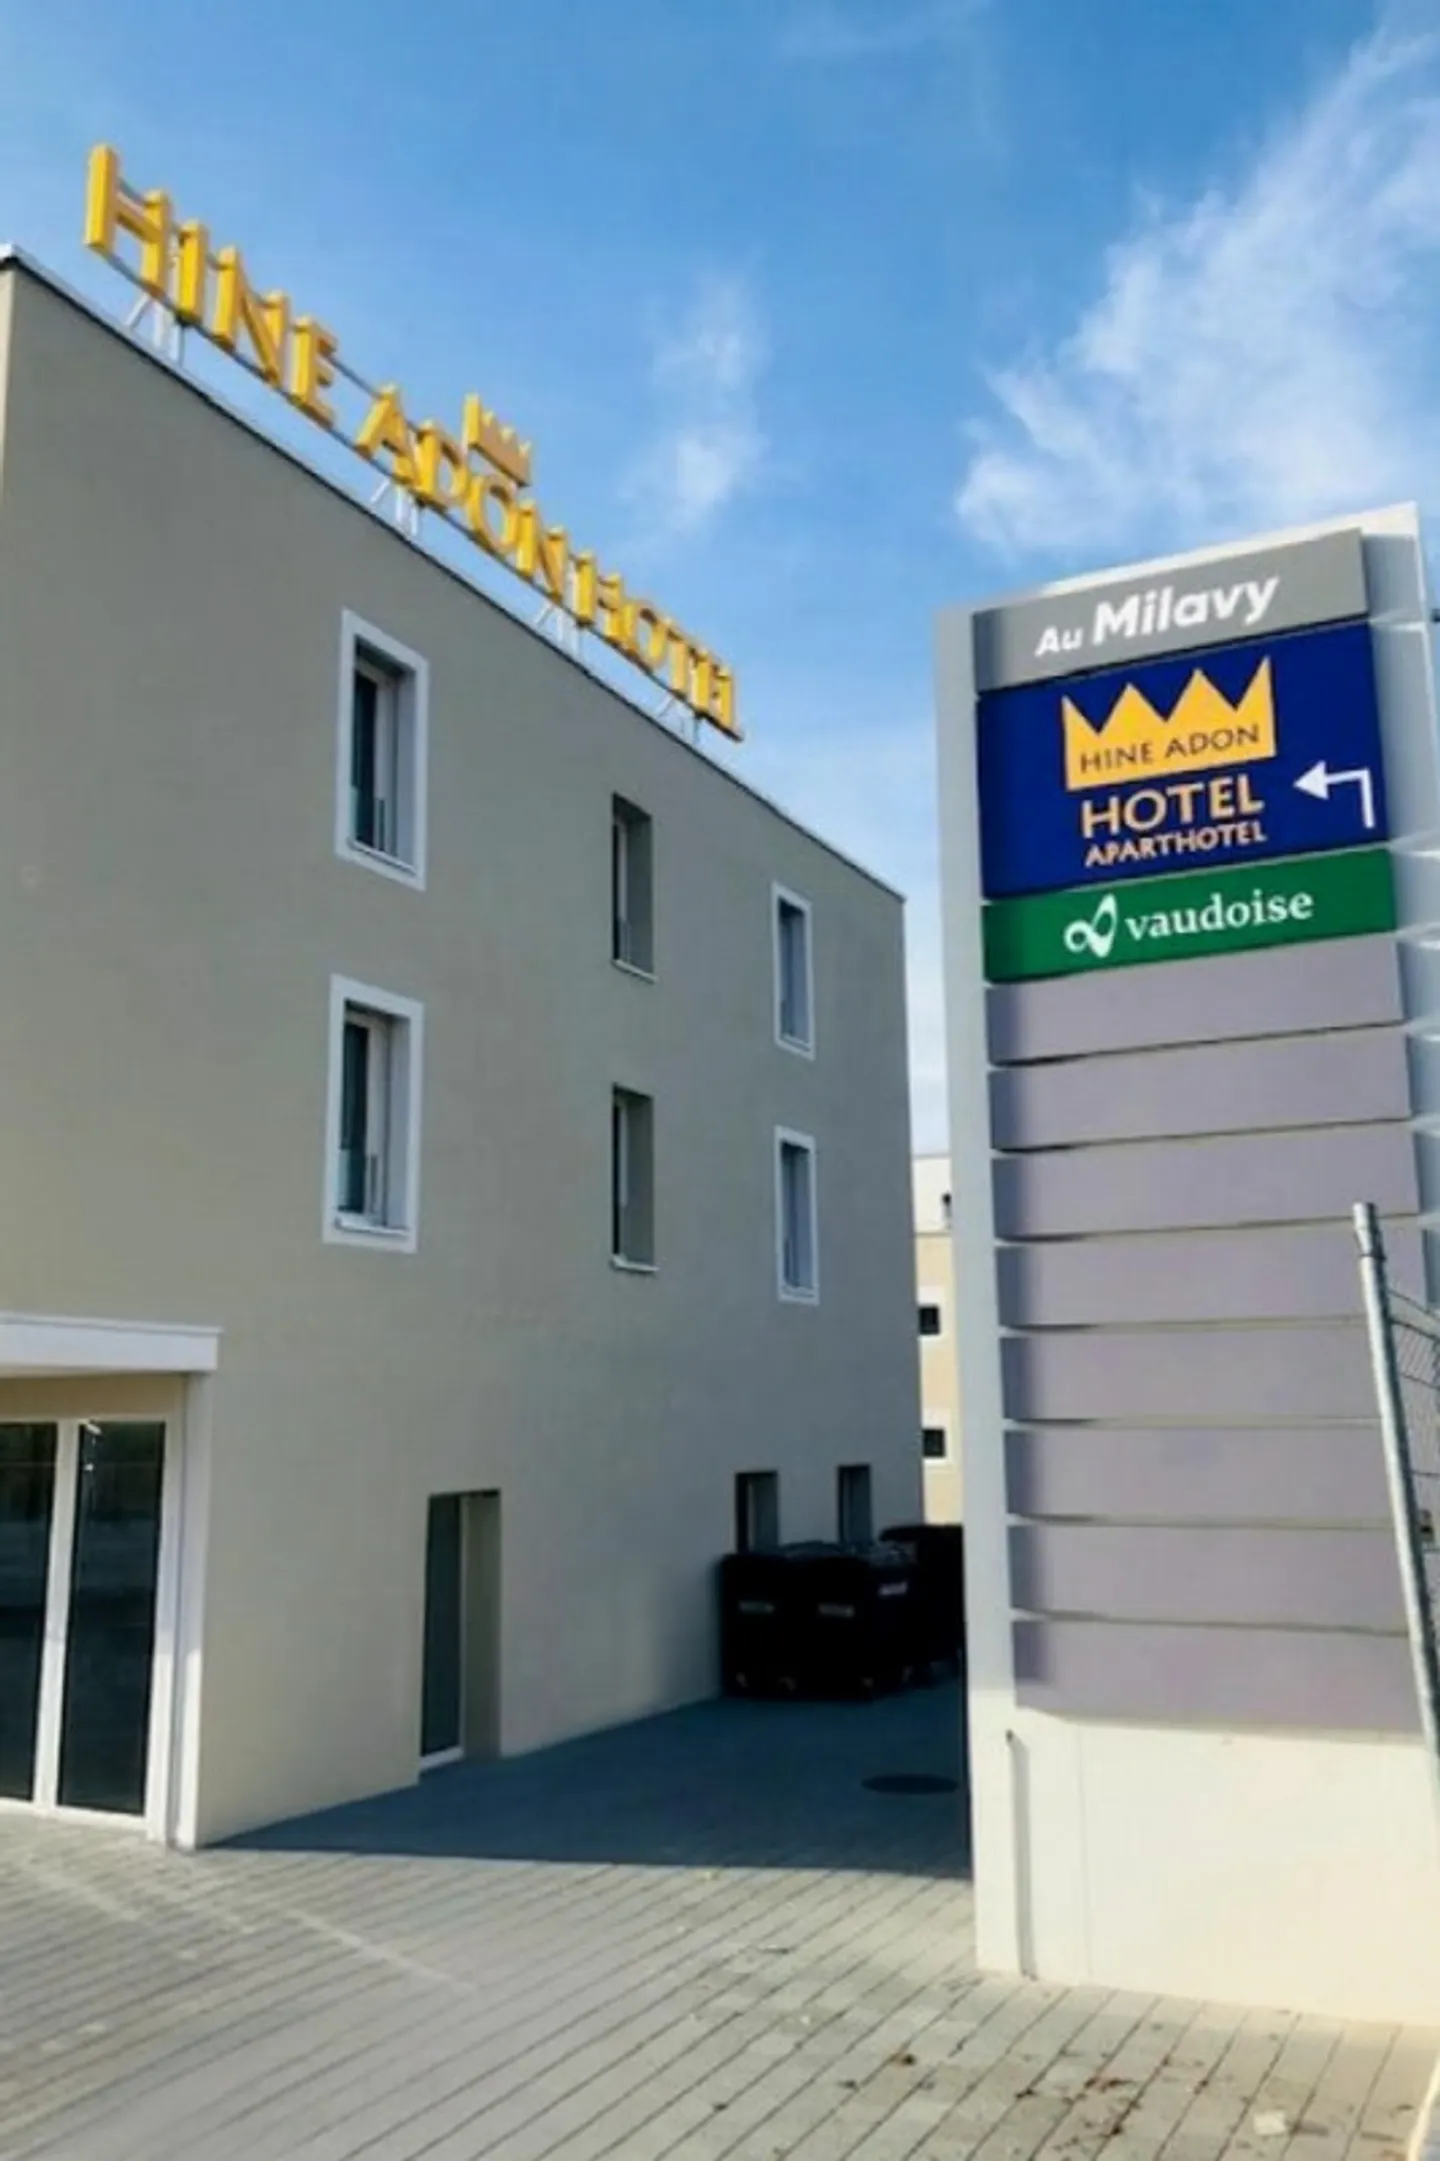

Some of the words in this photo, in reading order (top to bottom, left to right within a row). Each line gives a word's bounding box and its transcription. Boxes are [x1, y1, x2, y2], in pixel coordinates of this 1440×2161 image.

[84, 143, 337, 430] HINE
[355, 383, 568, 605] ADON
[575, 549, 744, 742] HOTEL
[1035, 624, 1082, 657] Au
[1092, 576, 1280, 646] Milavy
[1079, 741, 1154, 774] HINE
[1164, 723, 1261, 760] ADON
[1080, 774, 1265, 839] HOTEL
[1085, 819, 1267, 868] APARTHOTEL
[1124, 890, 1315, 942] vaudoise
